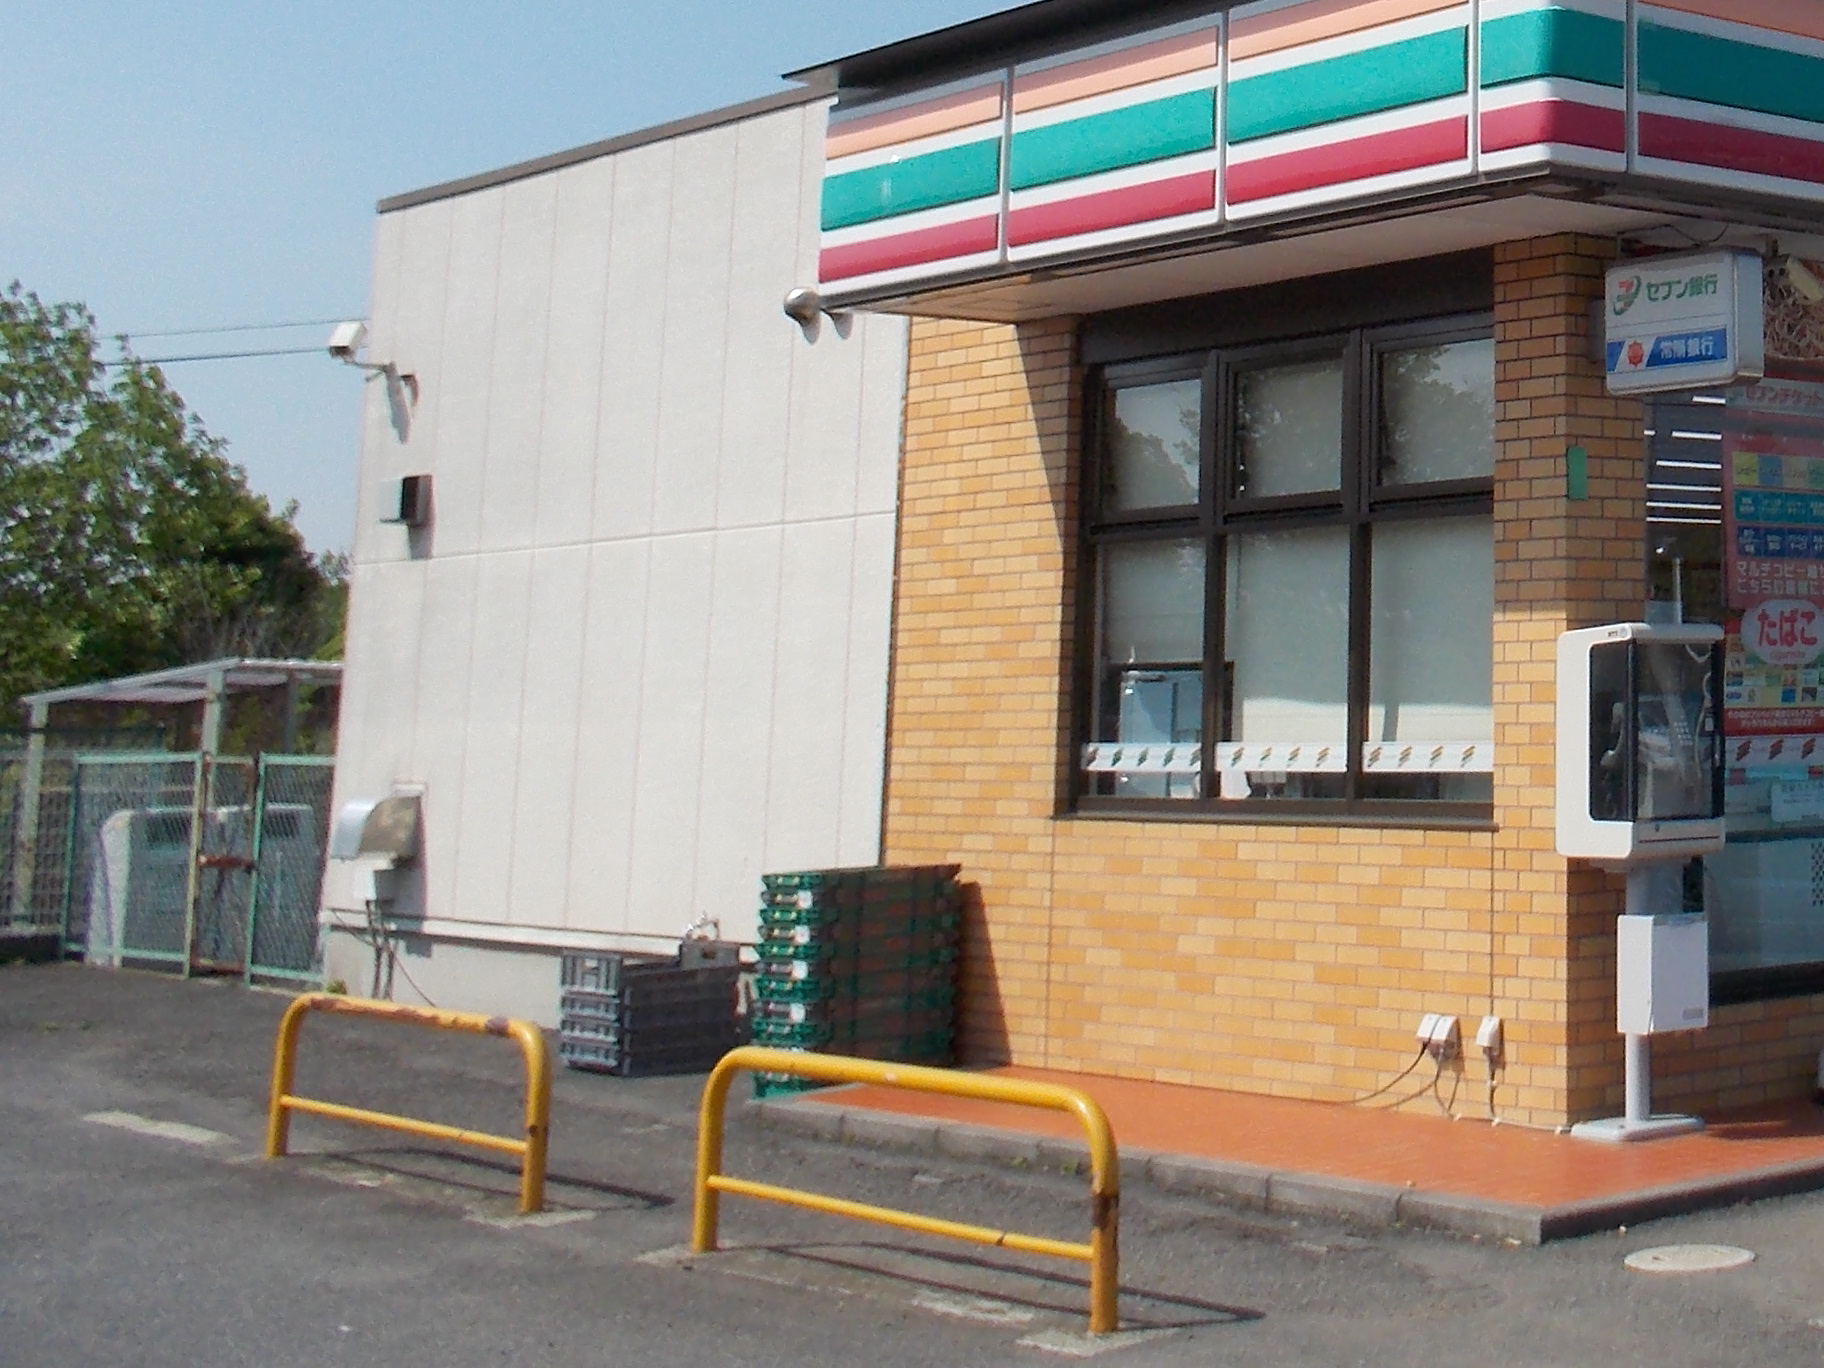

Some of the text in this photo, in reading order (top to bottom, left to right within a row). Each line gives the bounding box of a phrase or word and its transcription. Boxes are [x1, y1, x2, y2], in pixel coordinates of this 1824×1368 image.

[1646, 273, 1718, 303] セブン銀行
[1659, 336, 1715, 359] 常陽銀行
[1758, 608, 1818, 647] たばこ
